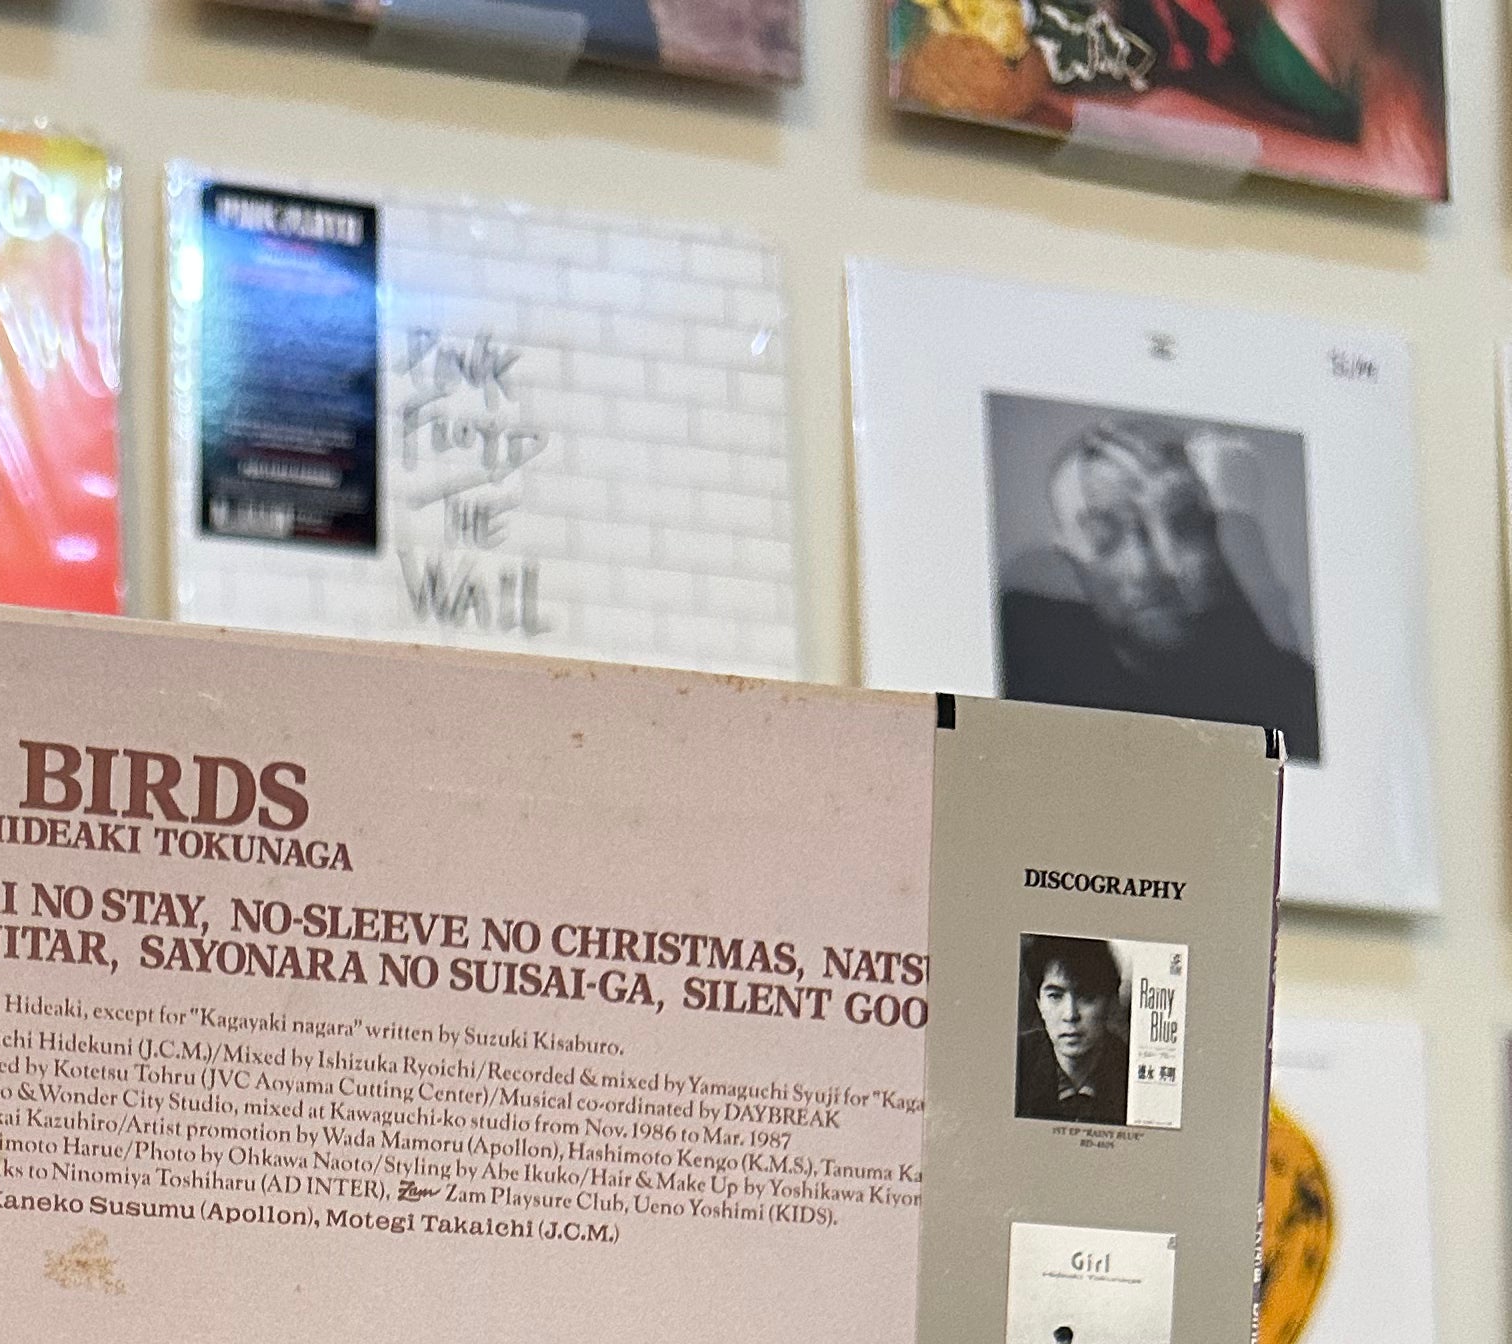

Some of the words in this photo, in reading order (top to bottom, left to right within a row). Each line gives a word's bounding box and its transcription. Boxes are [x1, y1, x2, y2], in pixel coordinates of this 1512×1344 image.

[17, 738, 309, 832] BIRDS
[152, 826, 354, 872] TOKUNAGA
[1024, 868, 1186, 900] DISCOGRAPHY
[30, 881, 94, 920] NO
[99, 886, 209, 937] STAY,
[229, 896, 470, 950] NO-SLEEVE
[480, 916, 541, 954] NO
[550, 921, 805, 981] CHRISTMAS,
[138, 933, 368, 985] SAYONARA
[377, 951, 439, 990] NO
[448, 955, 665, 1015] SUISAI-GA,
[681, 975, 833, 1021] SILENT
[1140, 977, 1175, 1020] Rainy
[3, 991, 89, 1021] Hideaki,
[91, 1005, 155, 1027] except
[158, 1003, 187, 1026] for
[363, 1020, 434, 1043] written
[437, 1021, 461, 1049] by
[462, 1024, 528, 1050] Suzuki
[531, 1029, 625, 1056] Kisaburo.
[1150, 1010, 1178, 1044] Blue
[37, 1029, 133, 1057] Hidekuni
[290, 1045, 315, 1073] by
[317, 1048, 398, 1074] Ishizuka
[578, 1066, 599, 1088] &
[600, 1068, 660, 1092] mixed
[662, 1071, 686, 1097] by
[687, 1073, 789, 1102] Yamaguchi
[791, 1081, 841, 1108] Syuji
[842, 1085, 870, 1108] for
[16, 1080, 38, 1103] &
[36, 1080, 119, 1107] Wonder
[121, 1087, 165, 1112] City
[167, 1089, 239, 1117] Studio,
[242, 1096, 304, 1119] mixed
[306, 1104, 325, 1121] at
[328, 1099, 467, 1128] Kawaguchi-ko
[469, 1110, 531, 1132] studio
[533, 1112, 580, 1136] from
[583, 1115, 628, 1139] Nov.
[630, 1120, 678, 1142] 1986
[679, 1127, 700, 1144] to
[701, 1123, 745, 1147] Mar.
[749, 1128, 793, 1151] 1987
[87, 1193, 196, 1220] Susumu
[198, 1198, 321, 1230] (Apollon),
[324, 1207, 416, 1235] Motegi
[419, 1212, 534, 1239] Takaichi
[536, 1217, 621, 1245] (J.C.M.)
[1071, 1251, 1110, 1273] Girl
